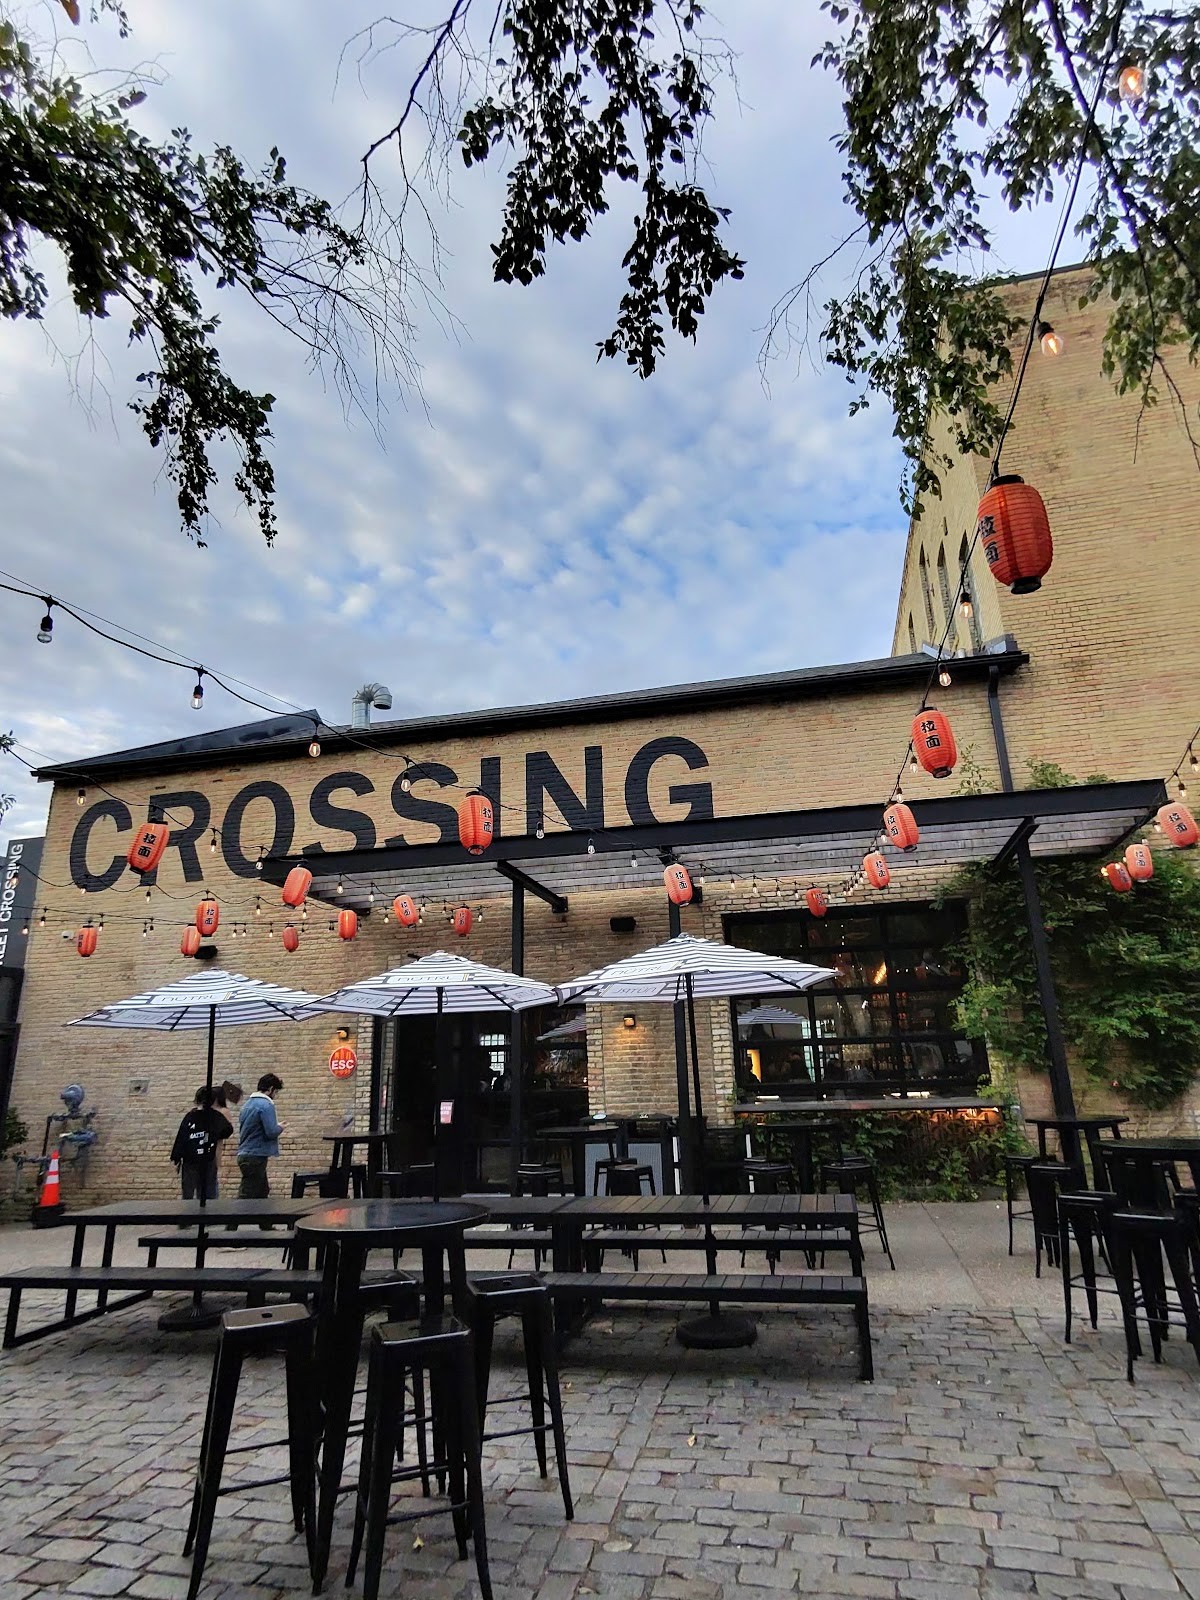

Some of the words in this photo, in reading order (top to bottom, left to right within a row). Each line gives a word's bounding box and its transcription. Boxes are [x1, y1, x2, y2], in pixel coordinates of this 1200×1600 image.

[920, 720, 941, 749] 拉面
[69, 736, 714, 893] CROSSING
[137, 832, 157, 858] 拉面
[0, 843, 24, 922] CROSSING
[331, 1059, 355, 1070] ESC
